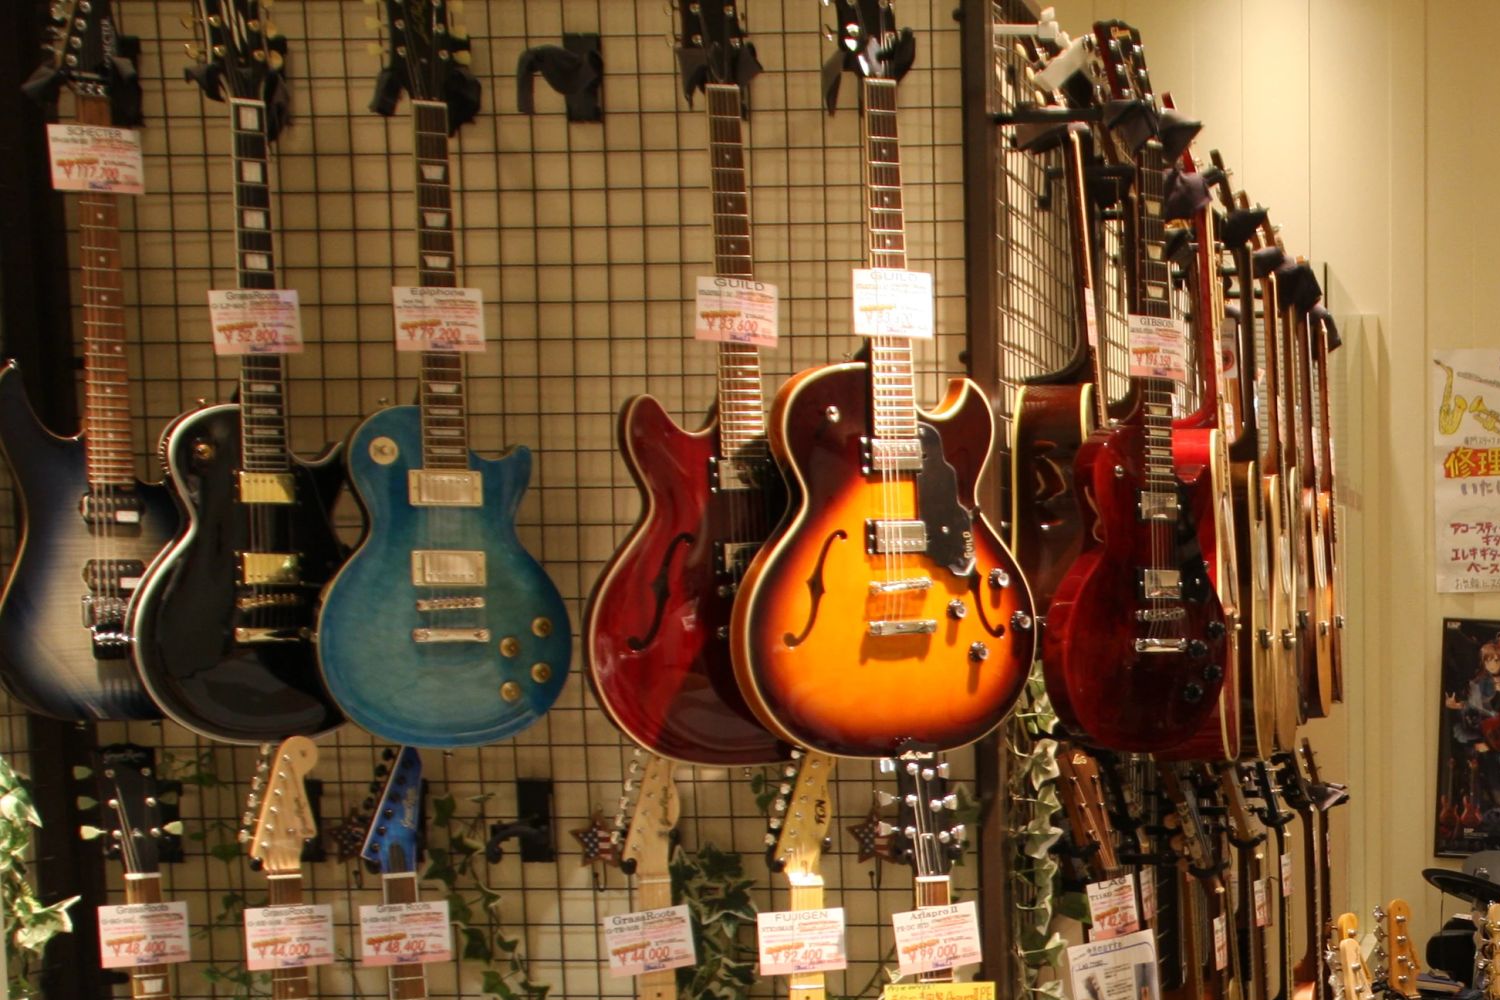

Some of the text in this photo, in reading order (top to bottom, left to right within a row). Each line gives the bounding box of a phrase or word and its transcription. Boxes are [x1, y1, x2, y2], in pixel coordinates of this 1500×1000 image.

[67, 127, 122, 138] SCHECTER
[870, 271, 918, 282] GUILD
[714, 278, 765, 291] GUILD
[1140, 318, 1174, 328] GIBSON
[1467, 562, 1500, 574] ベース
[1098, 876, 1127, 890] LAG
[612, 909, 676, 925] GrassRoots
[775, 911, 828, 922] FUJIGEN
